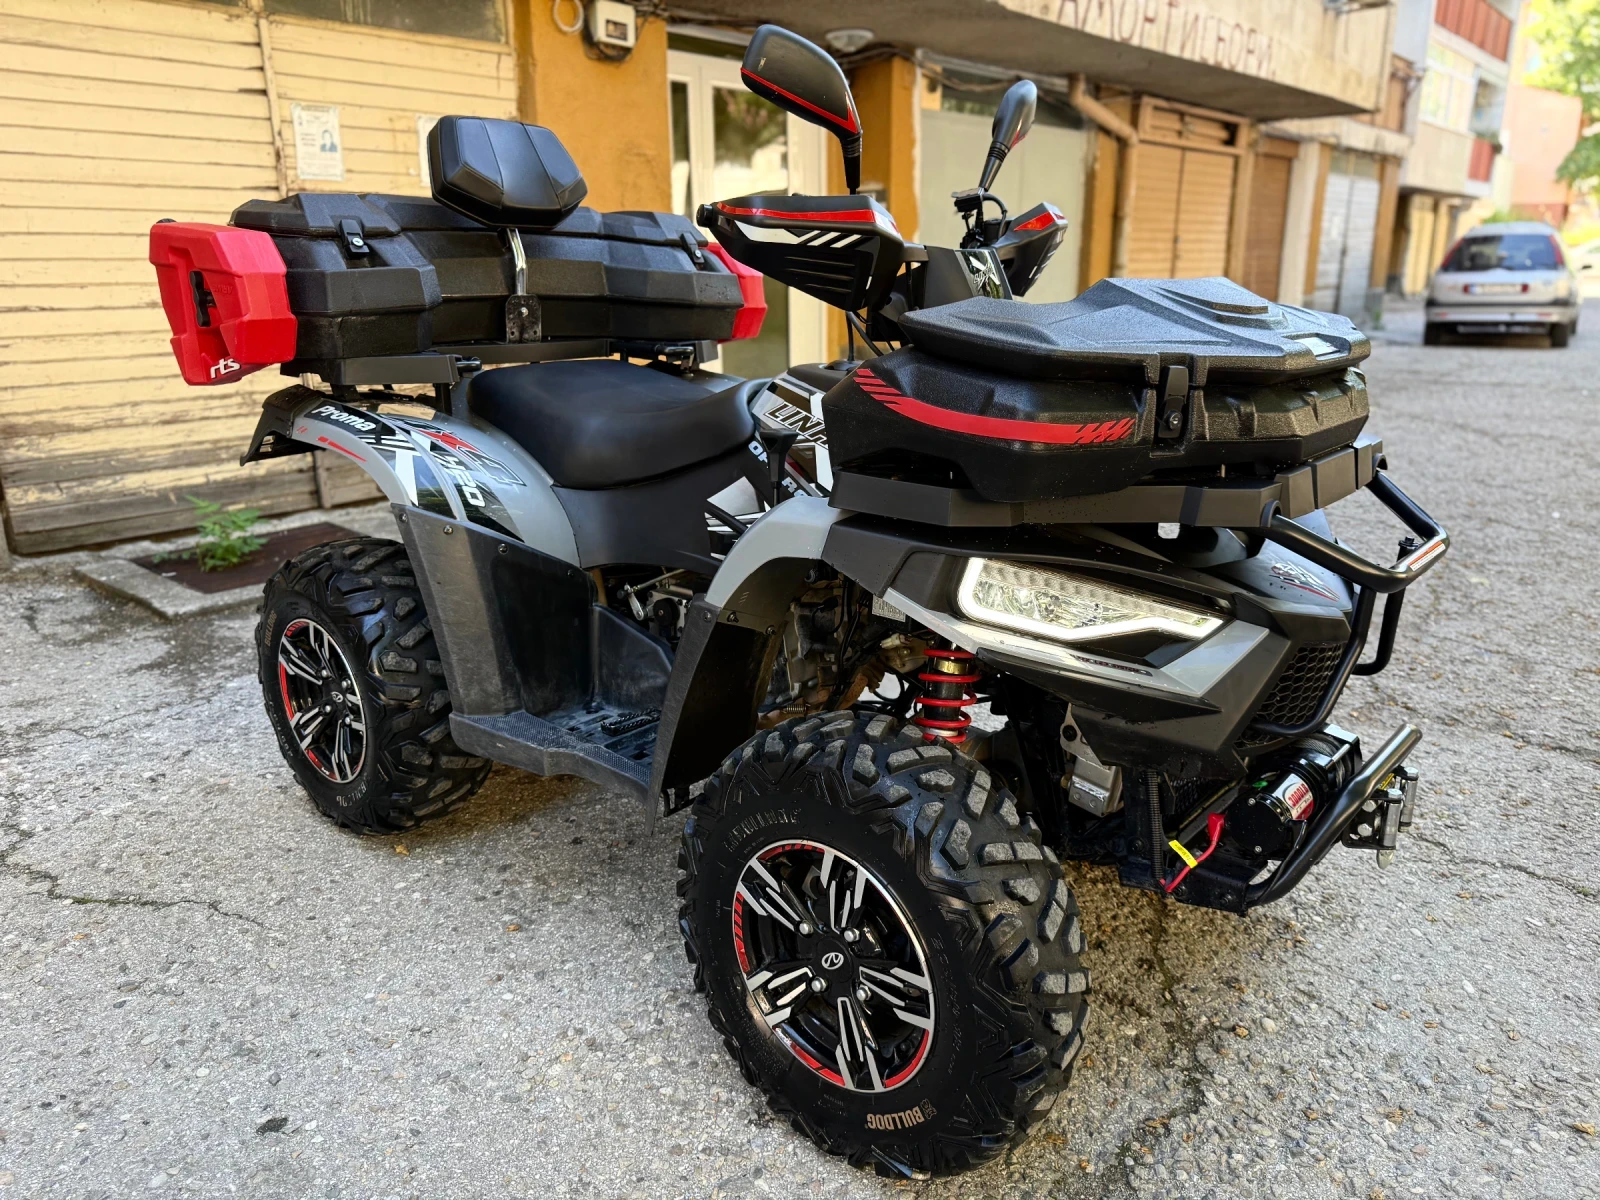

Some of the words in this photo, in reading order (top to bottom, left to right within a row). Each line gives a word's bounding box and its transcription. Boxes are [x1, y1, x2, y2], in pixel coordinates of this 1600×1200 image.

[210, 358, 240, 378] rts
[311, 405, 377, 431] Proma
[866, 1106, 925, 1130] BULLDOG
